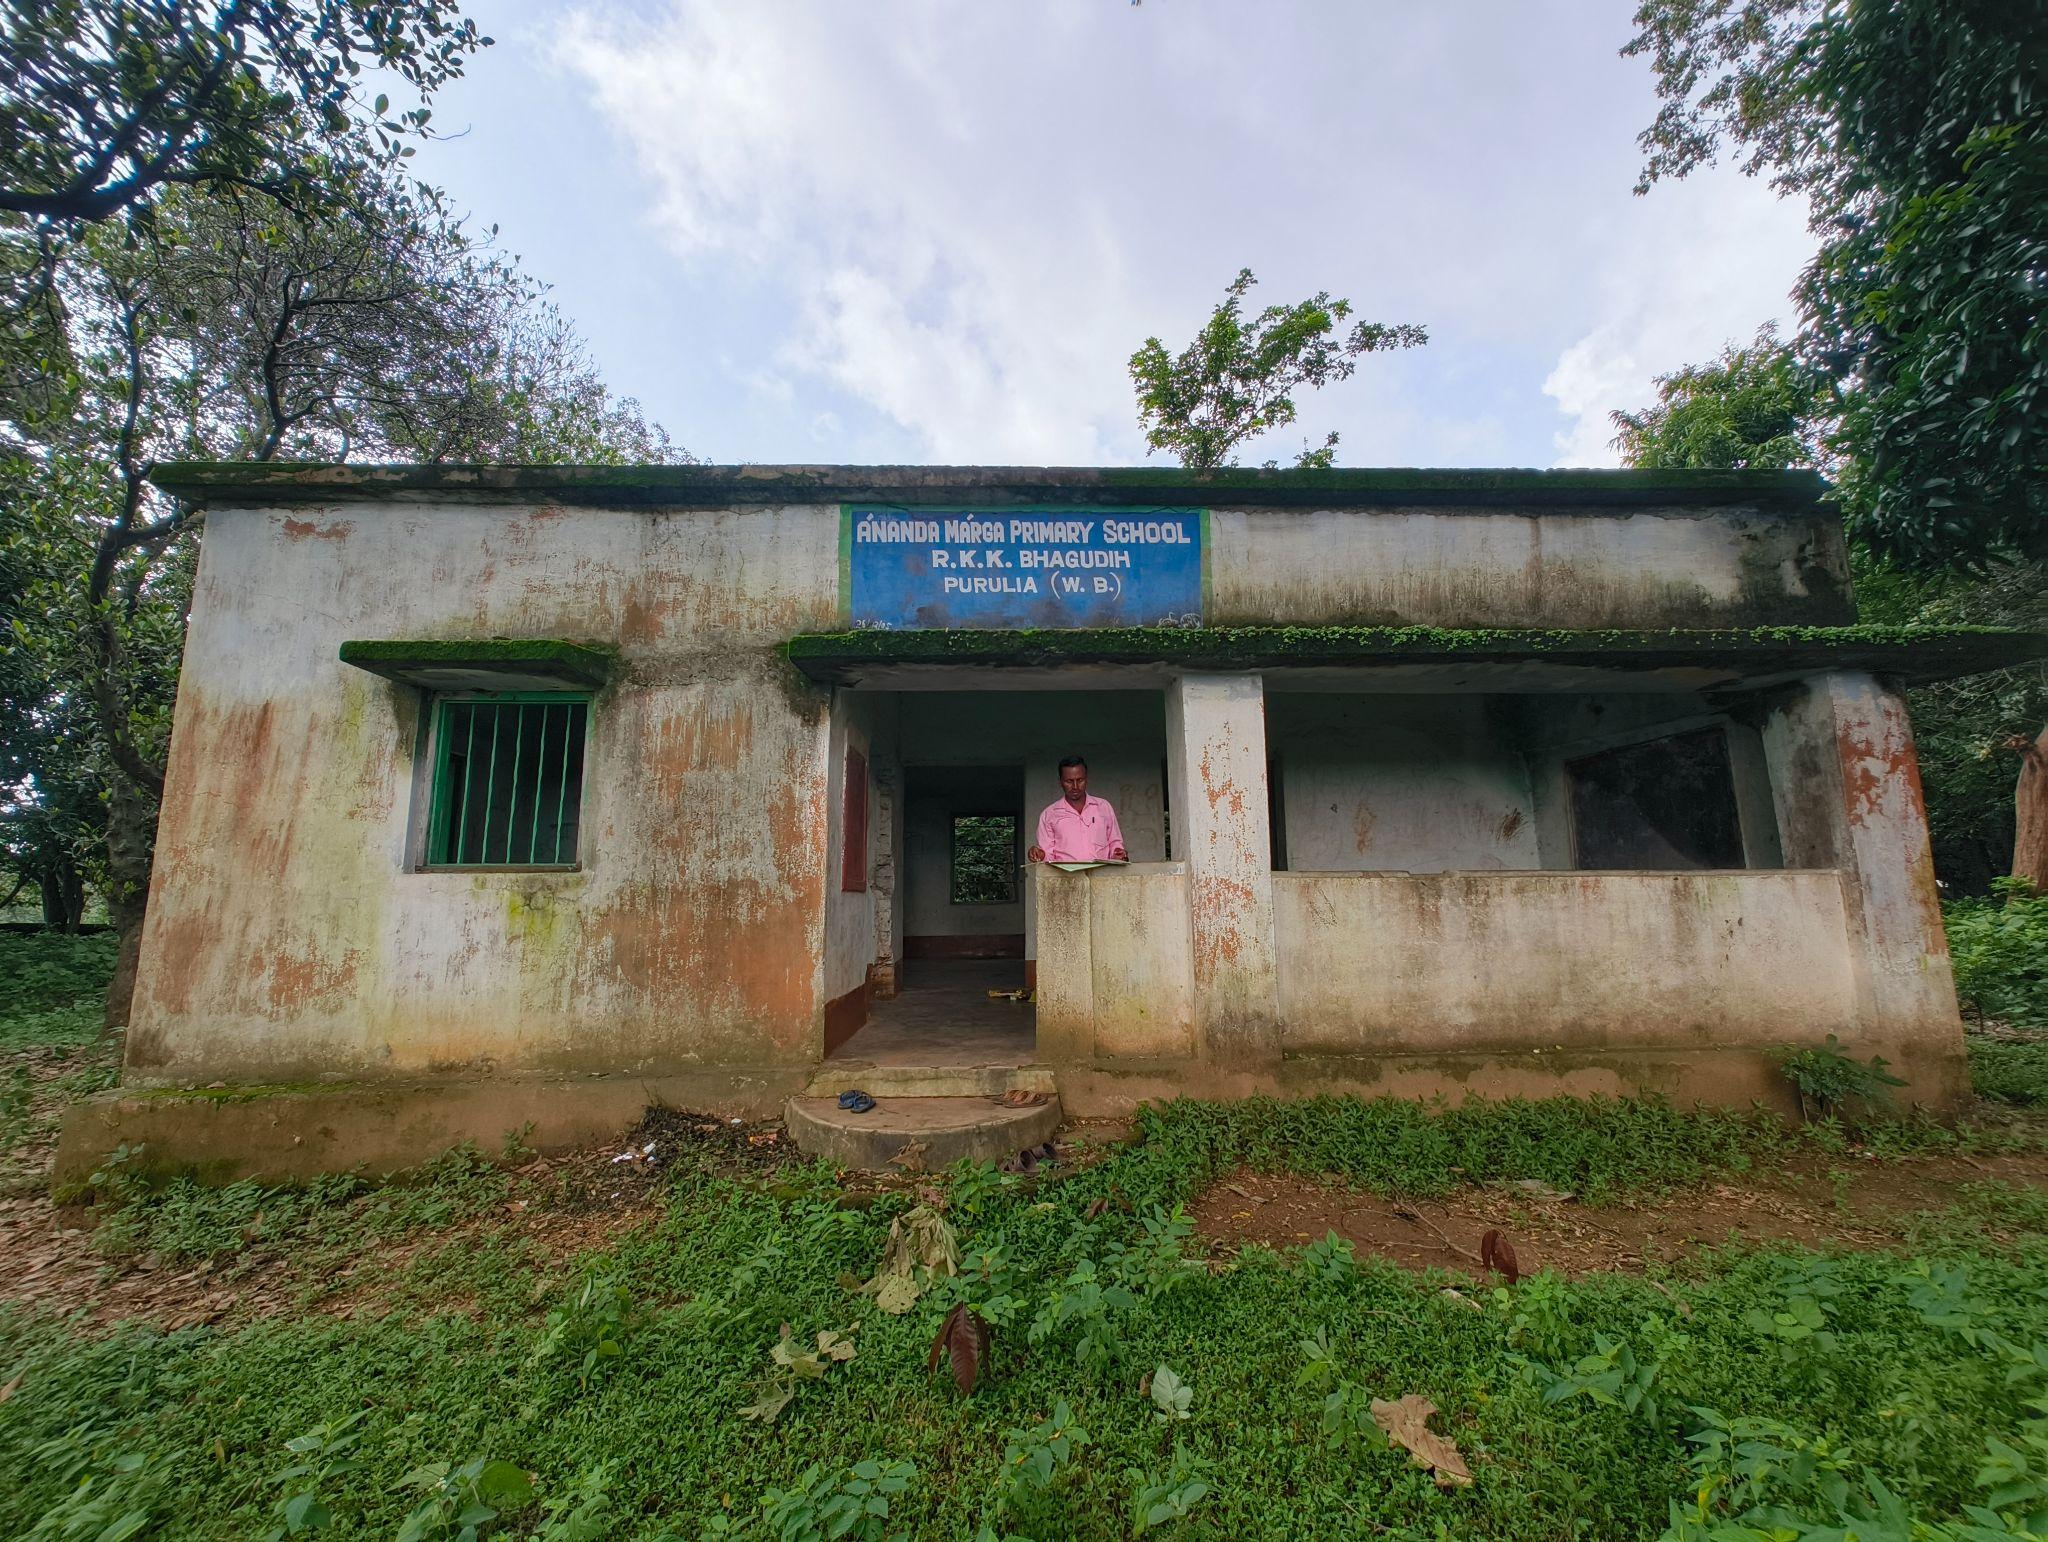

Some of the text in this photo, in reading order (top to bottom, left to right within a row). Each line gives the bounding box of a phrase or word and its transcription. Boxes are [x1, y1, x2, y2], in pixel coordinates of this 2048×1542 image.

[1010, 520, 1094, 544] PRIMARY
[1103, 519, 1191, 544] SCHOOL
[932, 550, 1131, 569] R.K.K. BHAGUDIH
[944, 577, 1038, 593] PURULIA
